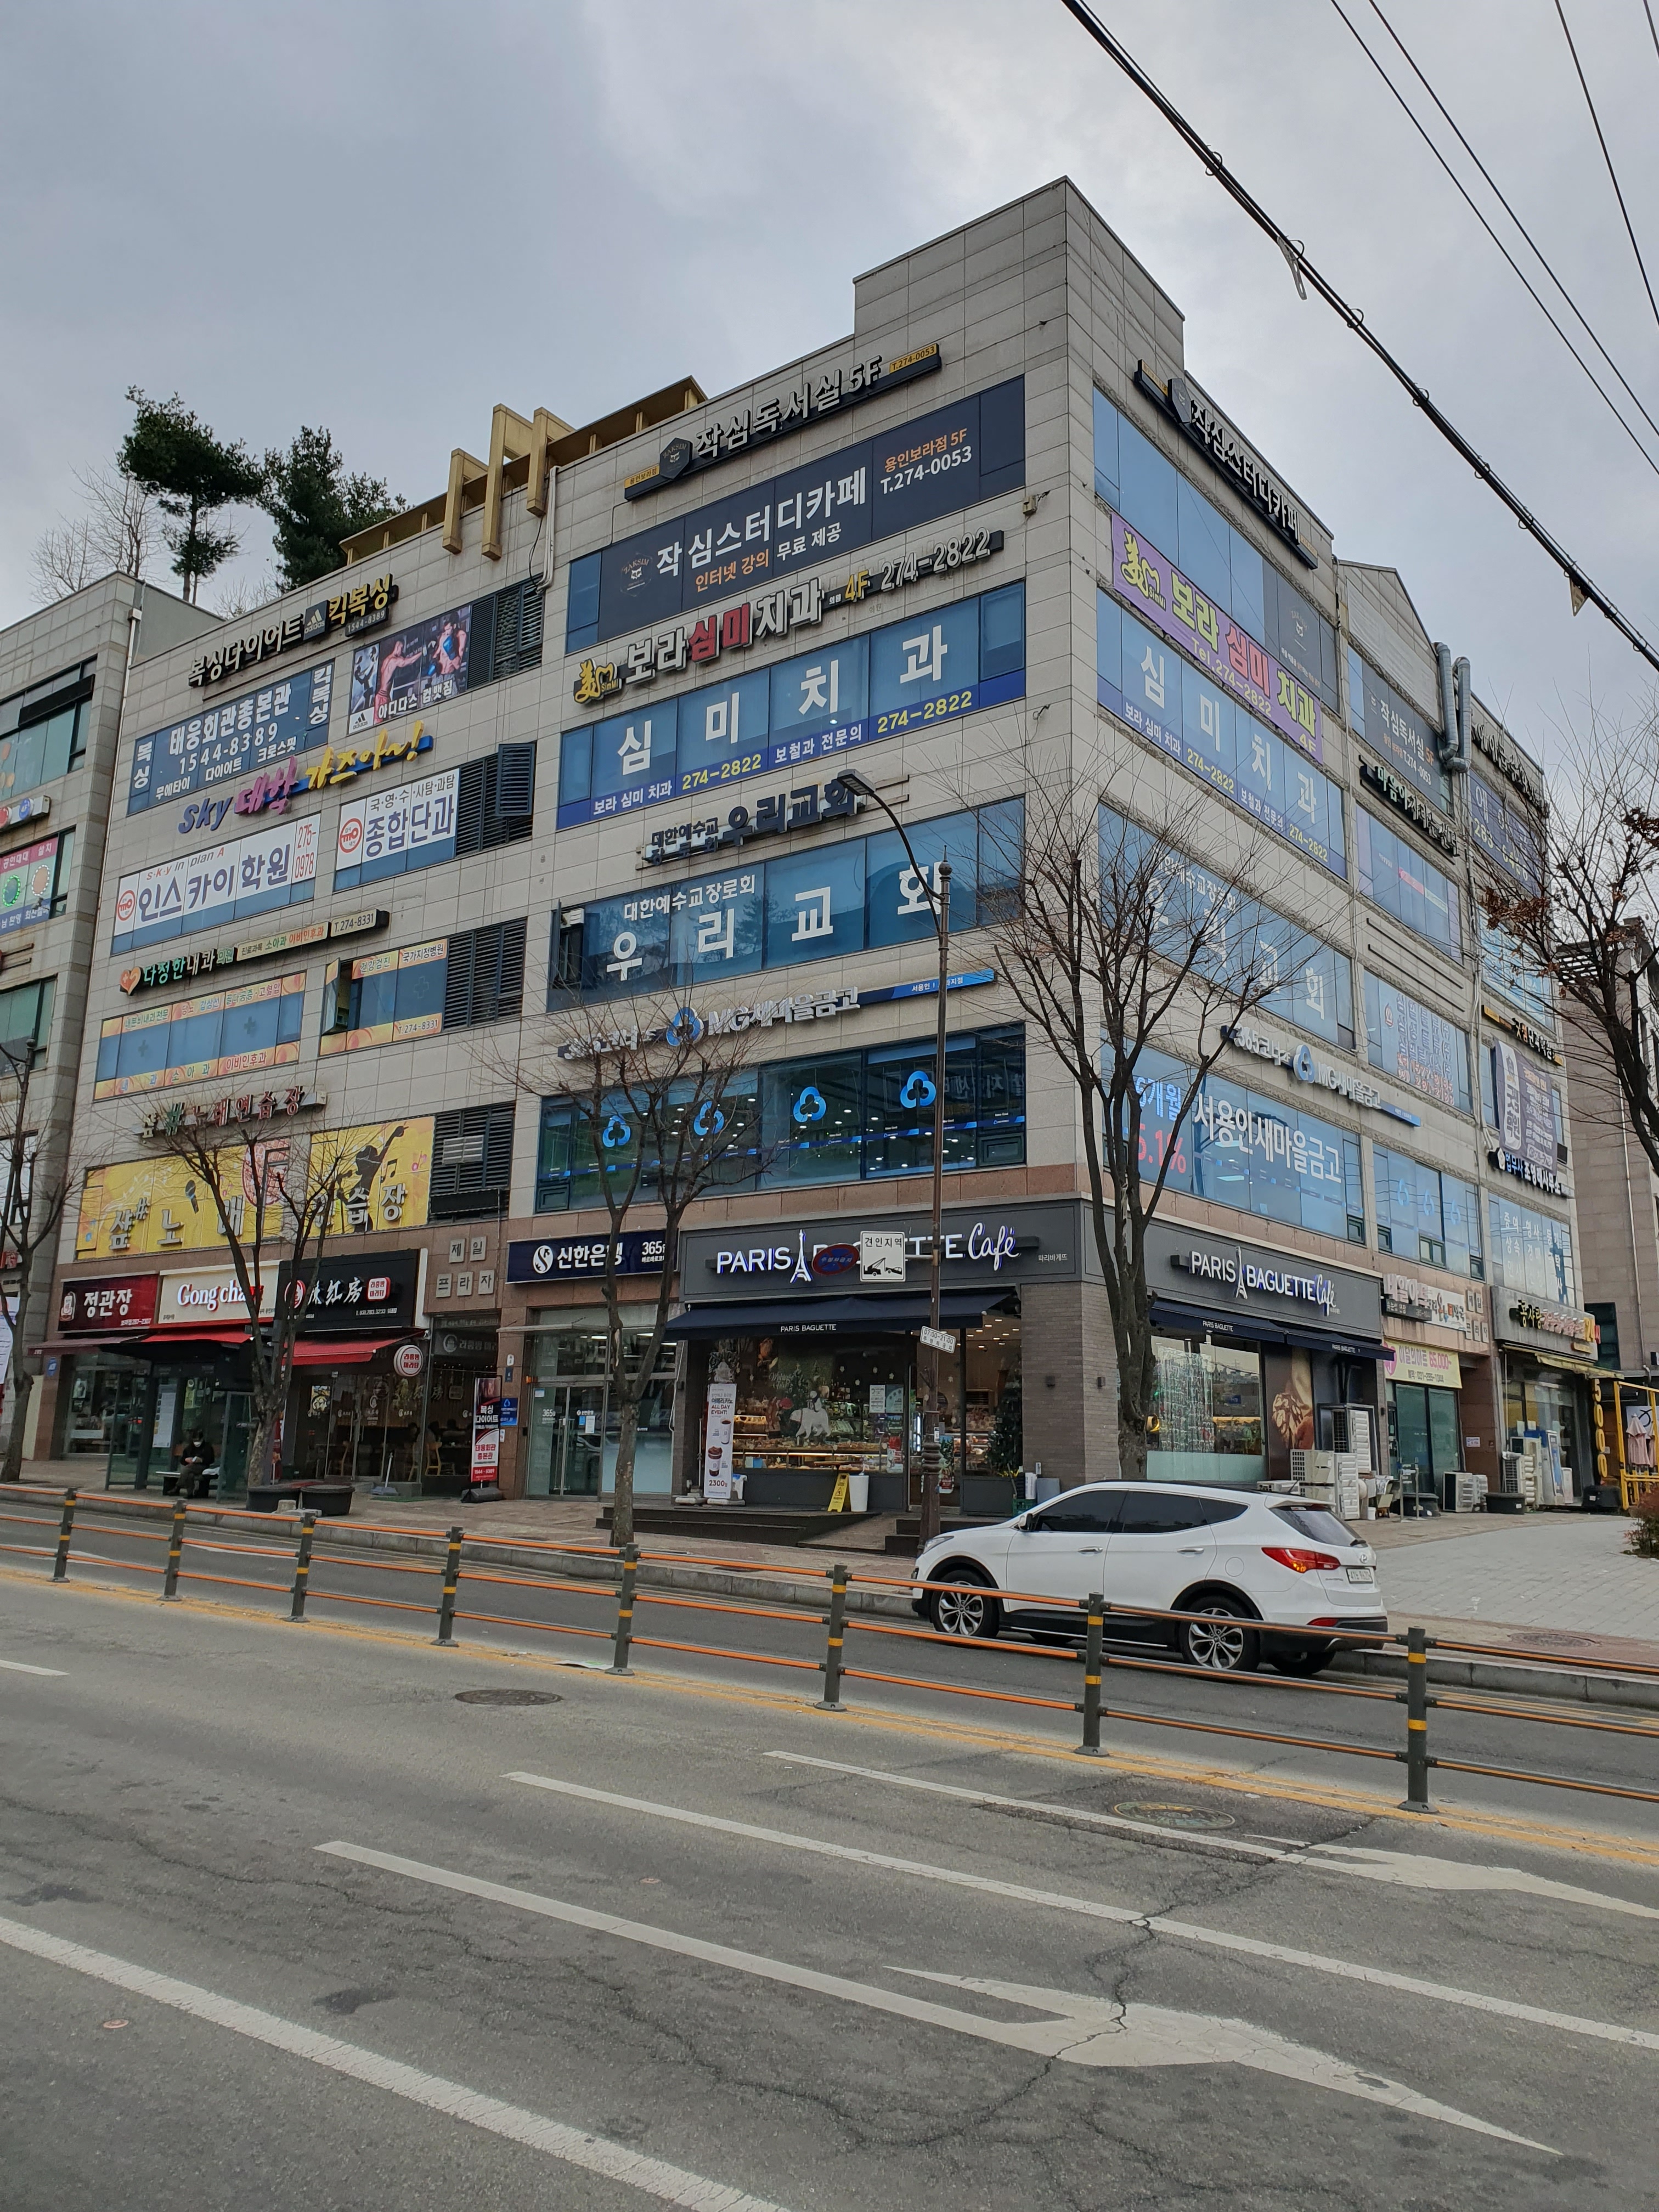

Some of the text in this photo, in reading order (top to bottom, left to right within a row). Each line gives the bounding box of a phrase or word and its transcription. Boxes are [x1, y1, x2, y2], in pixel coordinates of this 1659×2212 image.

[890, 345, 935, 372] T.274-0053
[697, 356, 881, 459] 작심독서실 5F
[881, 447, 972, 494] T.274-0053
[884, 428, 967, 473] 용인보라점 5F
[1192, 399, 1300, 543] 작심스터디카페
[657, 468, 866, 578] 작심스터디카페
[695, 523, 842, 592] 인터넷 강의 무료 제공
[844, 570, 870, 601] 4F
[881, 528, 990, 591] 274-2822
[188, 573, 392, 686] 복싱다이어트 킥복싱
[304, 620, 325, 634] adidas
[347, 610, 385, 633] 1544-8389
[1171, 569, 1219, 653] 보라
[1226, 625, 1271, 699] 심미
[1278, 669, 1316, 736] 치과
[170, 684, 291, 755] 태웅회관총본관
[379, 693, 417, 718] 아디다스
[179, 723, 278, 775] 1544-8389
[594, 691, 973, 815] 보라 심미 치과 274-2822 보철과 전문의 274-2822
[1299, 735, 1316, 753] 4F
[1380, 699, 1424, 762] 작심독서실
[134, 741, 153, 789] 복싱
[156, 736, 296, 800] 무에타이 다이어트 크로스핏
[1125, 703, 1328, 862] 보라 심미 치과 274-2822 보철과 전문의 274-2822
[178, 796, 233, 833] Sky
[365, 794, 454, 857] 종합단과
[652, 817, 719, 847] 대한예수교
[723, 780, 857, 845] 우리교회
[190, 850, 215, 868] plan
[217, 847, 225, 858] A
[294, 851, 314, 880] 0978
[624, 876, 757, 921] 대한예수교장로회
[144, 955, 216, 986] 다정한내과
[264, 936, 286, 950] 소아과
[289, 926, 325, 944] 이비인후과
[334, 913, 375, 933] T.274-8331
[360, 944, 443, 974] 건강검진 국가지정병원
[912, 983, 930, 991] 서용인
[398, 1019, 437, 1035] T.274-8331
[226, 1052, 267, 1071] 이비인후과
[1194, 1092, 1341, 1183] 서용인새마을금고
[452, 1242, 482, 1257] 제일
[717, 1246, 792, 1274] PARIS
[865, 1237, 902, 1248] 견인지역
[968, 1222, 1019, 1271] Café
[1038, 1254, 1068, 1262] 파리바게뜨
[84, 1289, 133, 1318] 정관장
[177, 1283, 219, 1311] Gong
[438, 1274, 492, 1290] 프라자
[1191, 1251, 1336, 1316] PARIS BAGUETTE Café
[802, 1324, 837, 1332] BAGUETTE
[924, 1329, 953, 1344] 07:00-21:00
